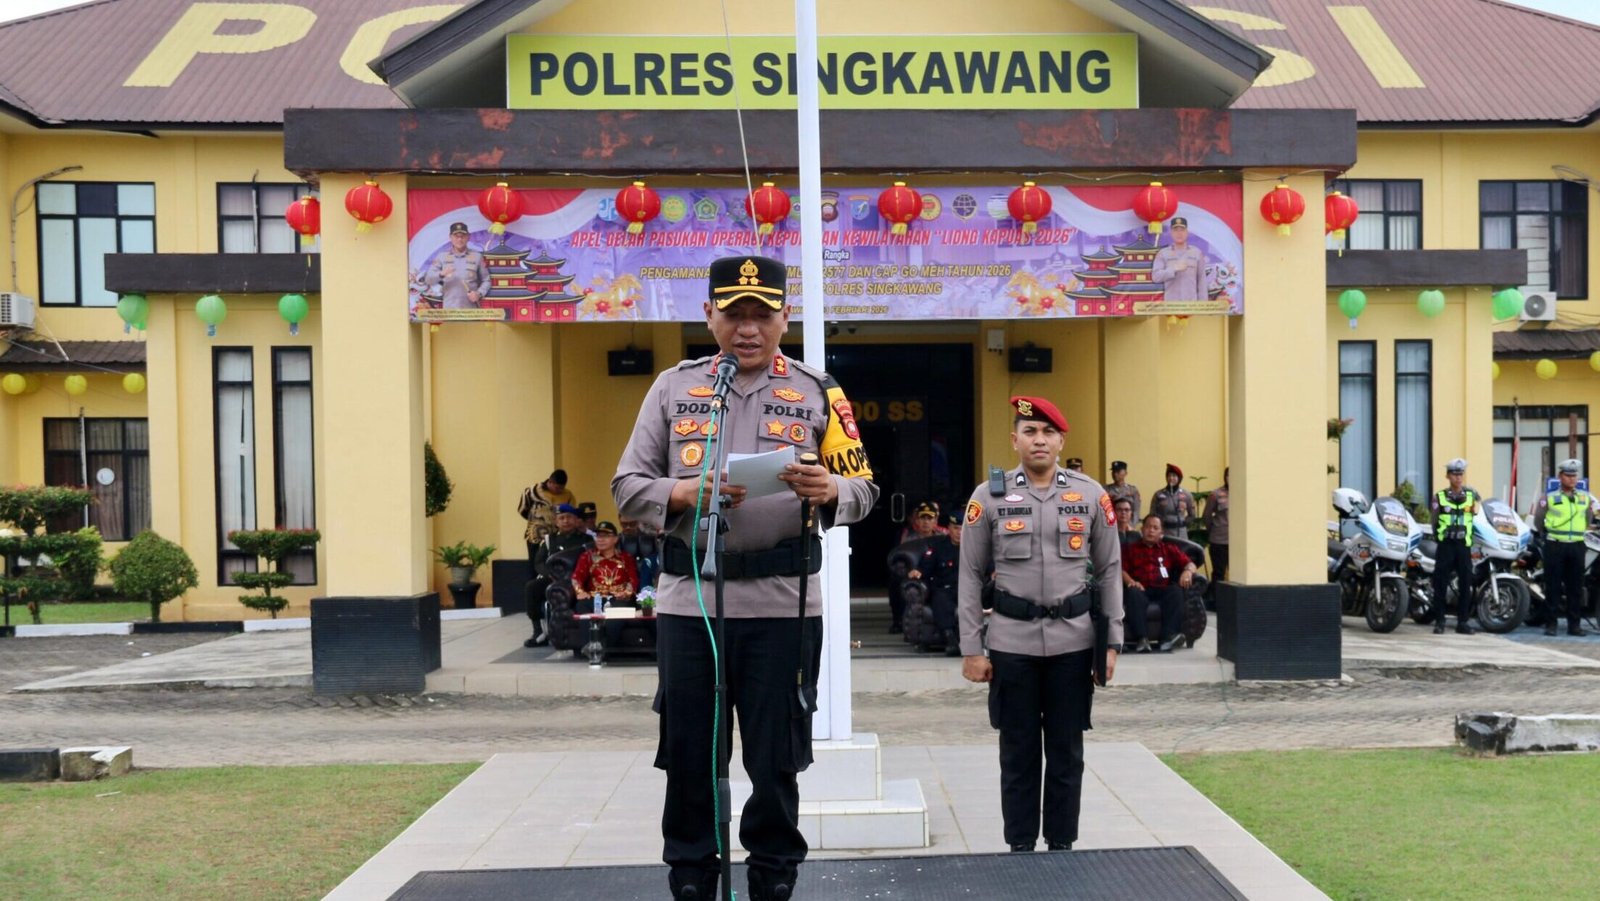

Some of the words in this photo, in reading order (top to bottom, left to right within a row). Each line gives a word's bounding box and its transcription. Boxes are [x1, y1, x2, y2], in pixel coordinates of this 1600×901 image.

[530, 51, 735, 96] POLRES
[752, 49, 1111, 96] SINGKAWANG
[571, 231, 602, 248] APEL
[650, 231, 708, 248] PASUKAN
[711, 231, 764, 248] OPERASI
[843, 229, 931, 247] KEWILAYAHAN
[983, 229, 1032, 246] KAPUAS
[823, 250, 850, 262] Rangka
[640, 266, 711, 279] PENGAMANA
[848, 265, 872, 278] DAN
[875, 265, 898, 278] CAP
[901, 265, 918, 278] GO
[921, 265, 945, 278] MEH
[947, 265, 983, 277] TAHUN
[986, 264, 1012, 277] 2026
[867, 282, 943, 296] SINGKAWANG
[676, 402, 711, 414] DOD
[763, 404, 812, 421] POLRI
[825, 451, 850, 476] KA
[1058, 505, 1089, 515] POLRI
